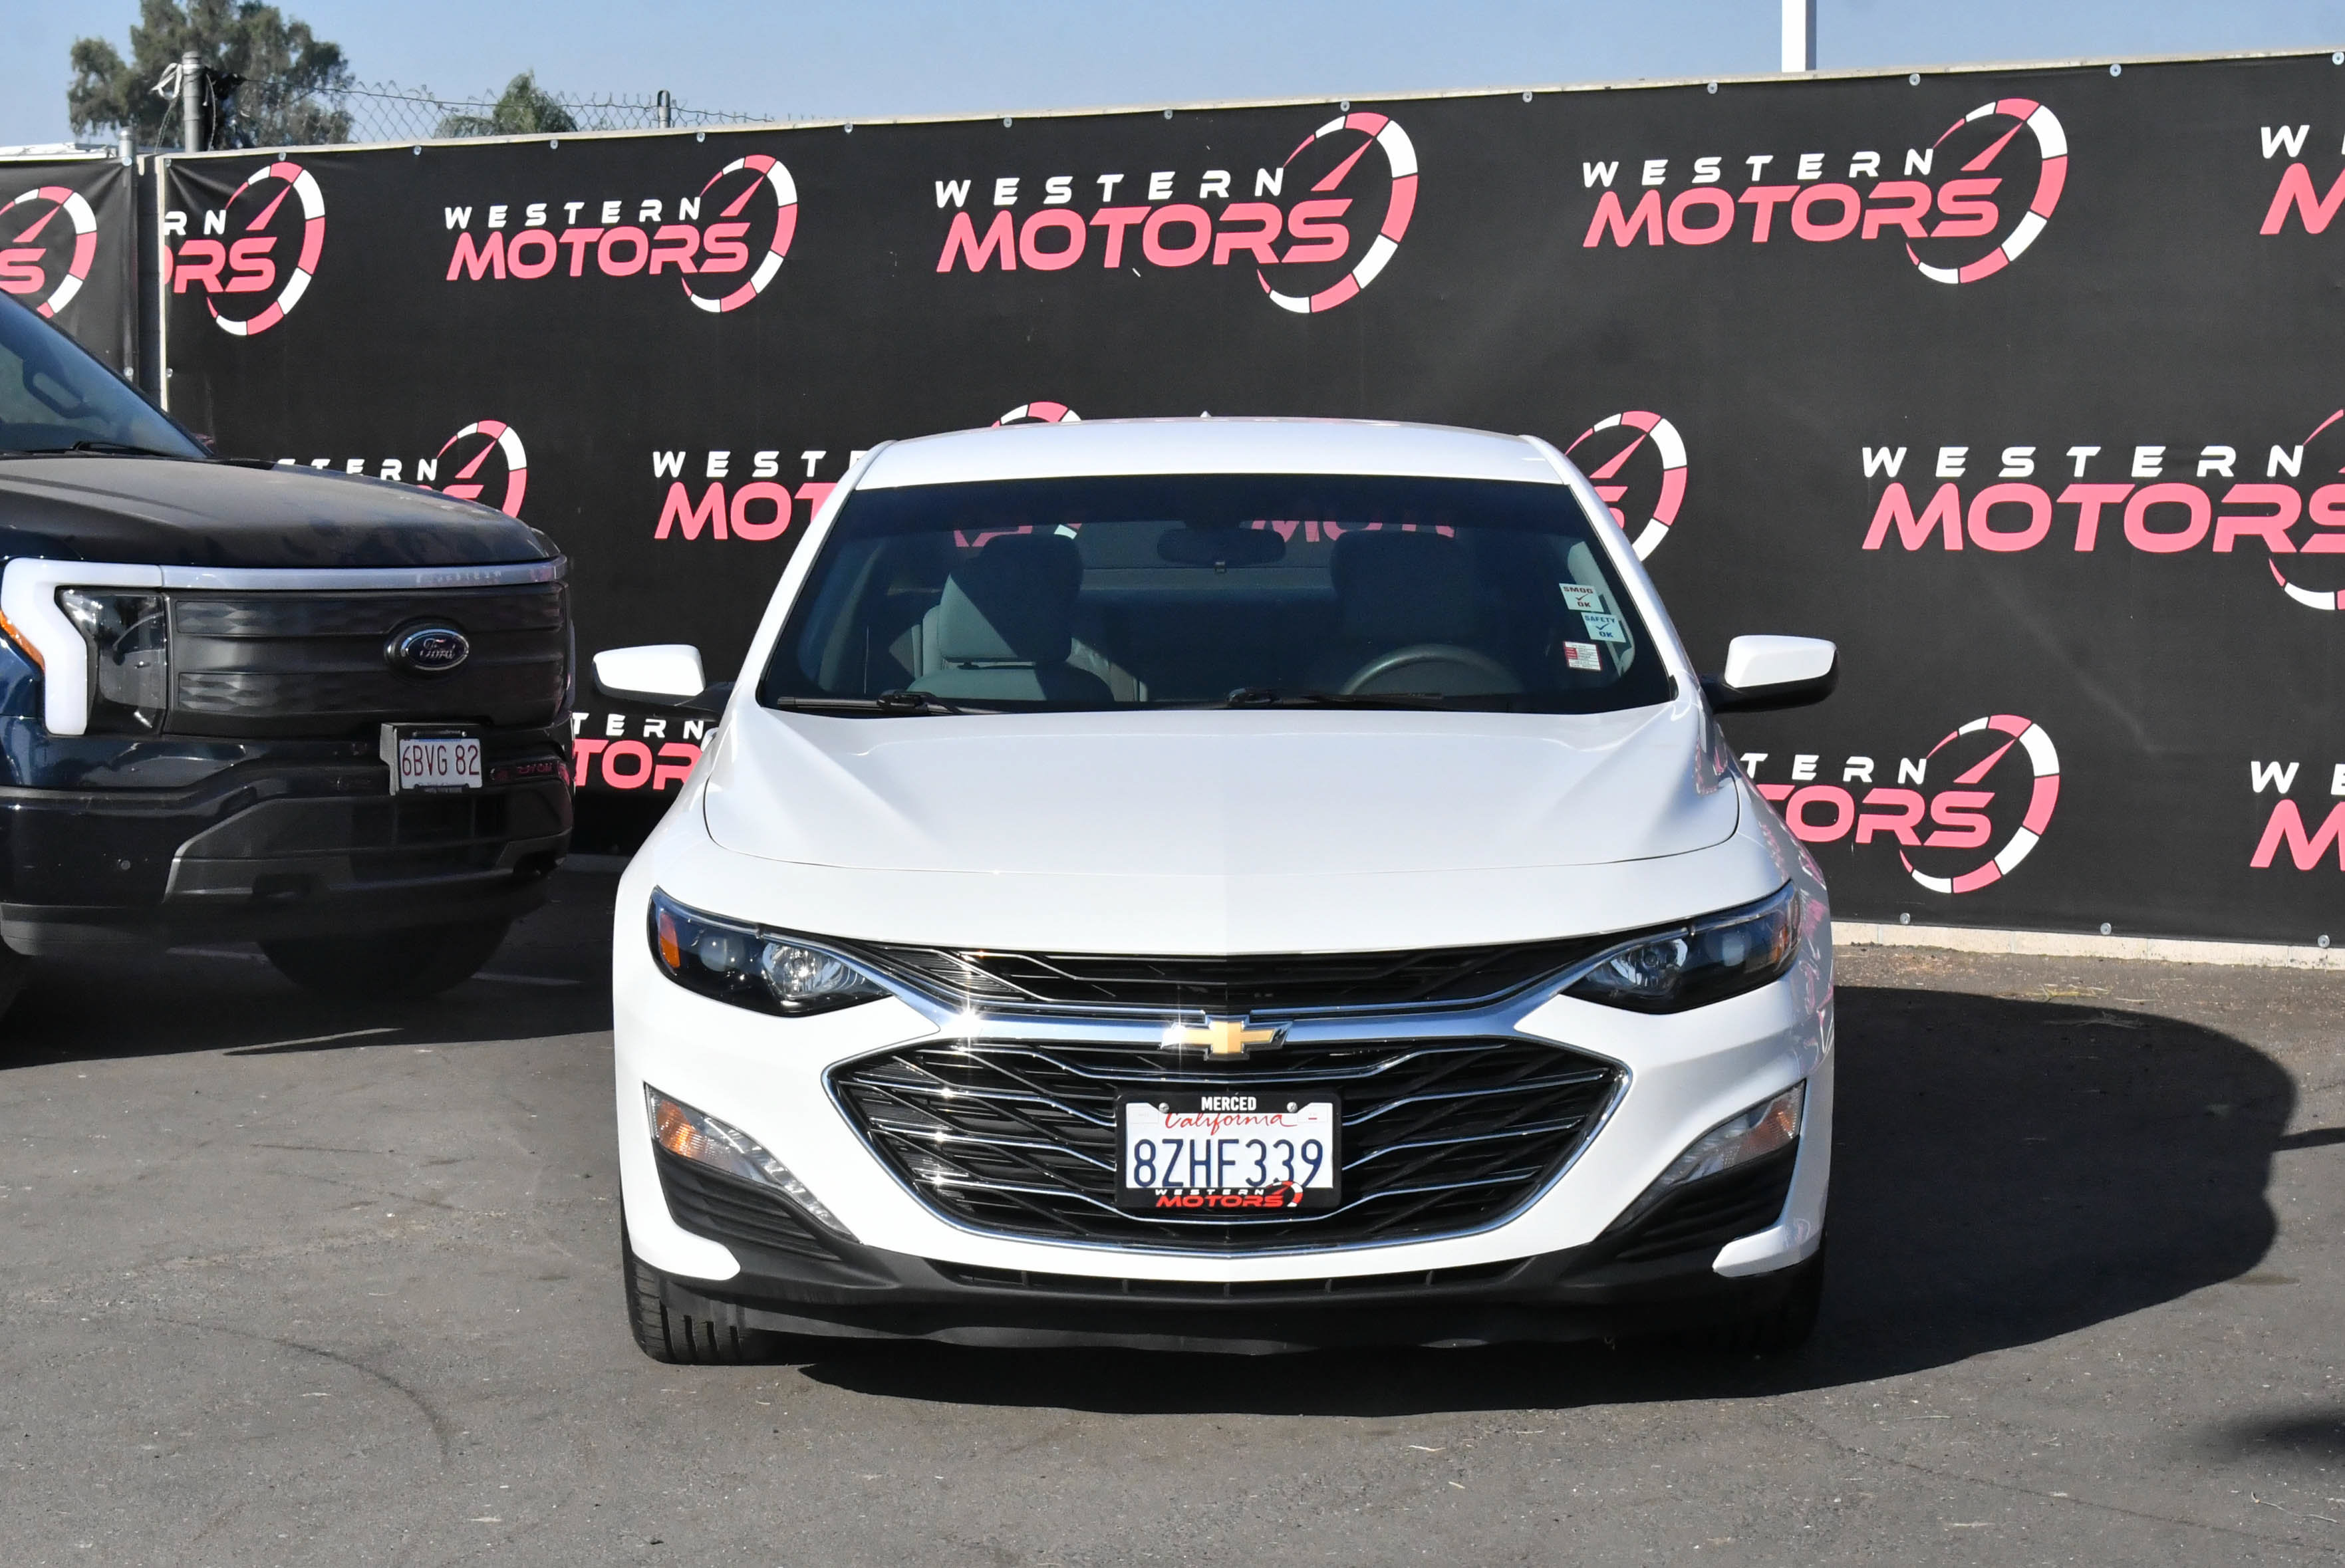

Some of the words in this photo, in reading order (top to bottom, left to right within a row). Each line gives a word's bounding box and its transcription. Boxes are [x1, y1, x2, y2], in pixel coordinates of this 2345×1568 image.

[2261, 125, 2345, 158] W
[1583, 149, 1934, 188] WESTERN
[935, 167, 1284, 208] WESTERN
[445, 197, 701, 229] WESTERN
[1583, 178, 2002, 248] MOTORS
[446, 222, 751, 281] MOTORS
[936, 198, 1353, 273] MOTORS
[1862, 445, 2304, 477] WESTERN
[419, 638, 457, 660] Ford
[402, 744, 448, 777] 6BVG
[455, 744, 480, 776] 82
[2250, 799, 2345, 871] M
[1201, 1096, 1257, 1111] MERCED
[1164, 1112, 1298, 1136] California
[1133, 1138, 1323, 1188] 8ZHF339
[1155, 1195, 1284, 1208] MOTORS
